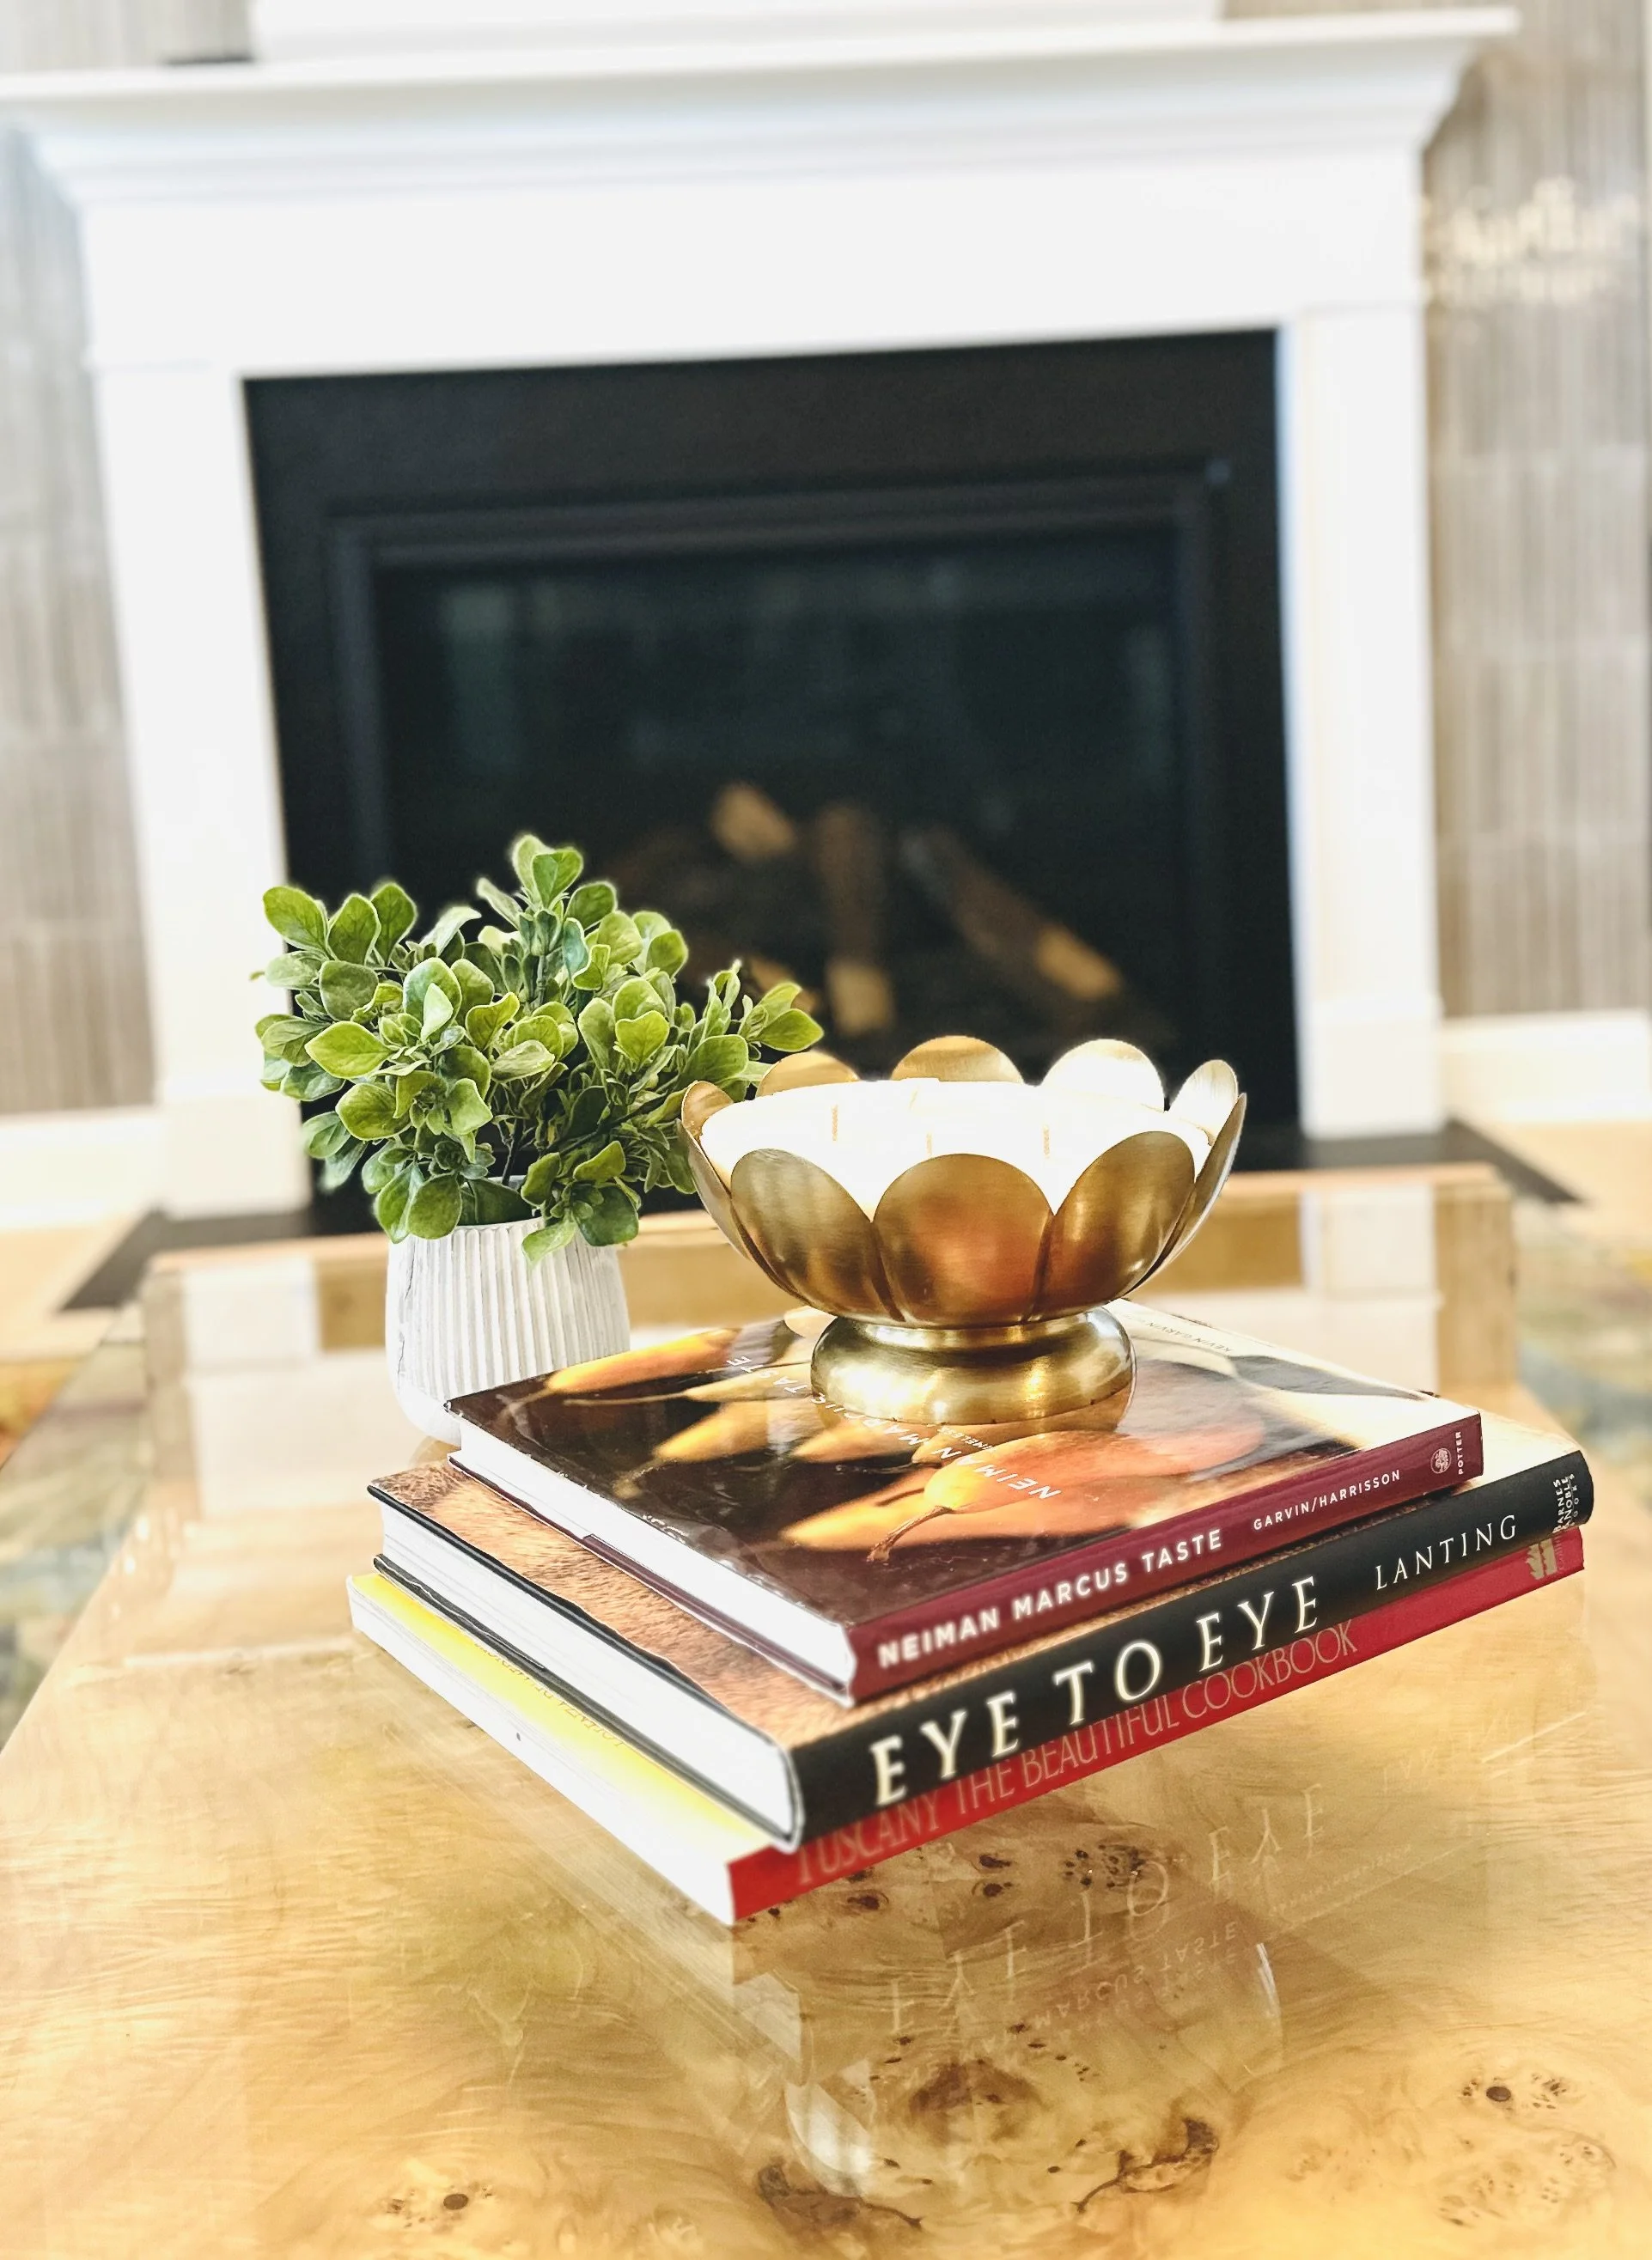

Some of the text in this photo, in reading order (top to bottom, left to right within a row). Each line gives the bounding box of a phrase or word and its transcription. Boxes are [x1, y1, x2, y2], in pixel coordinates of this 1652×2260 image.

[726, 1355, 808, 1394] TASTE
[931, 1447, 1063, 1500] NEIMAN
[1551, 1478, 1564, 1534] BARNES
[877, 1431, 1464, 1669] NEIMAN MARCUS TASTE GARVIN/HARRISSON POTTER
[869, 1690, 1021, 1806] EYE
[1052, 1639, 1164, 1726] TO
[1196, 1575, 1319, 1672] EYE
[1375, 1514, 1516, 1591] LANTING
[798, 1618, 1358, 1885] TUSCANY THE BEAUTIFUL COOKBOOK
